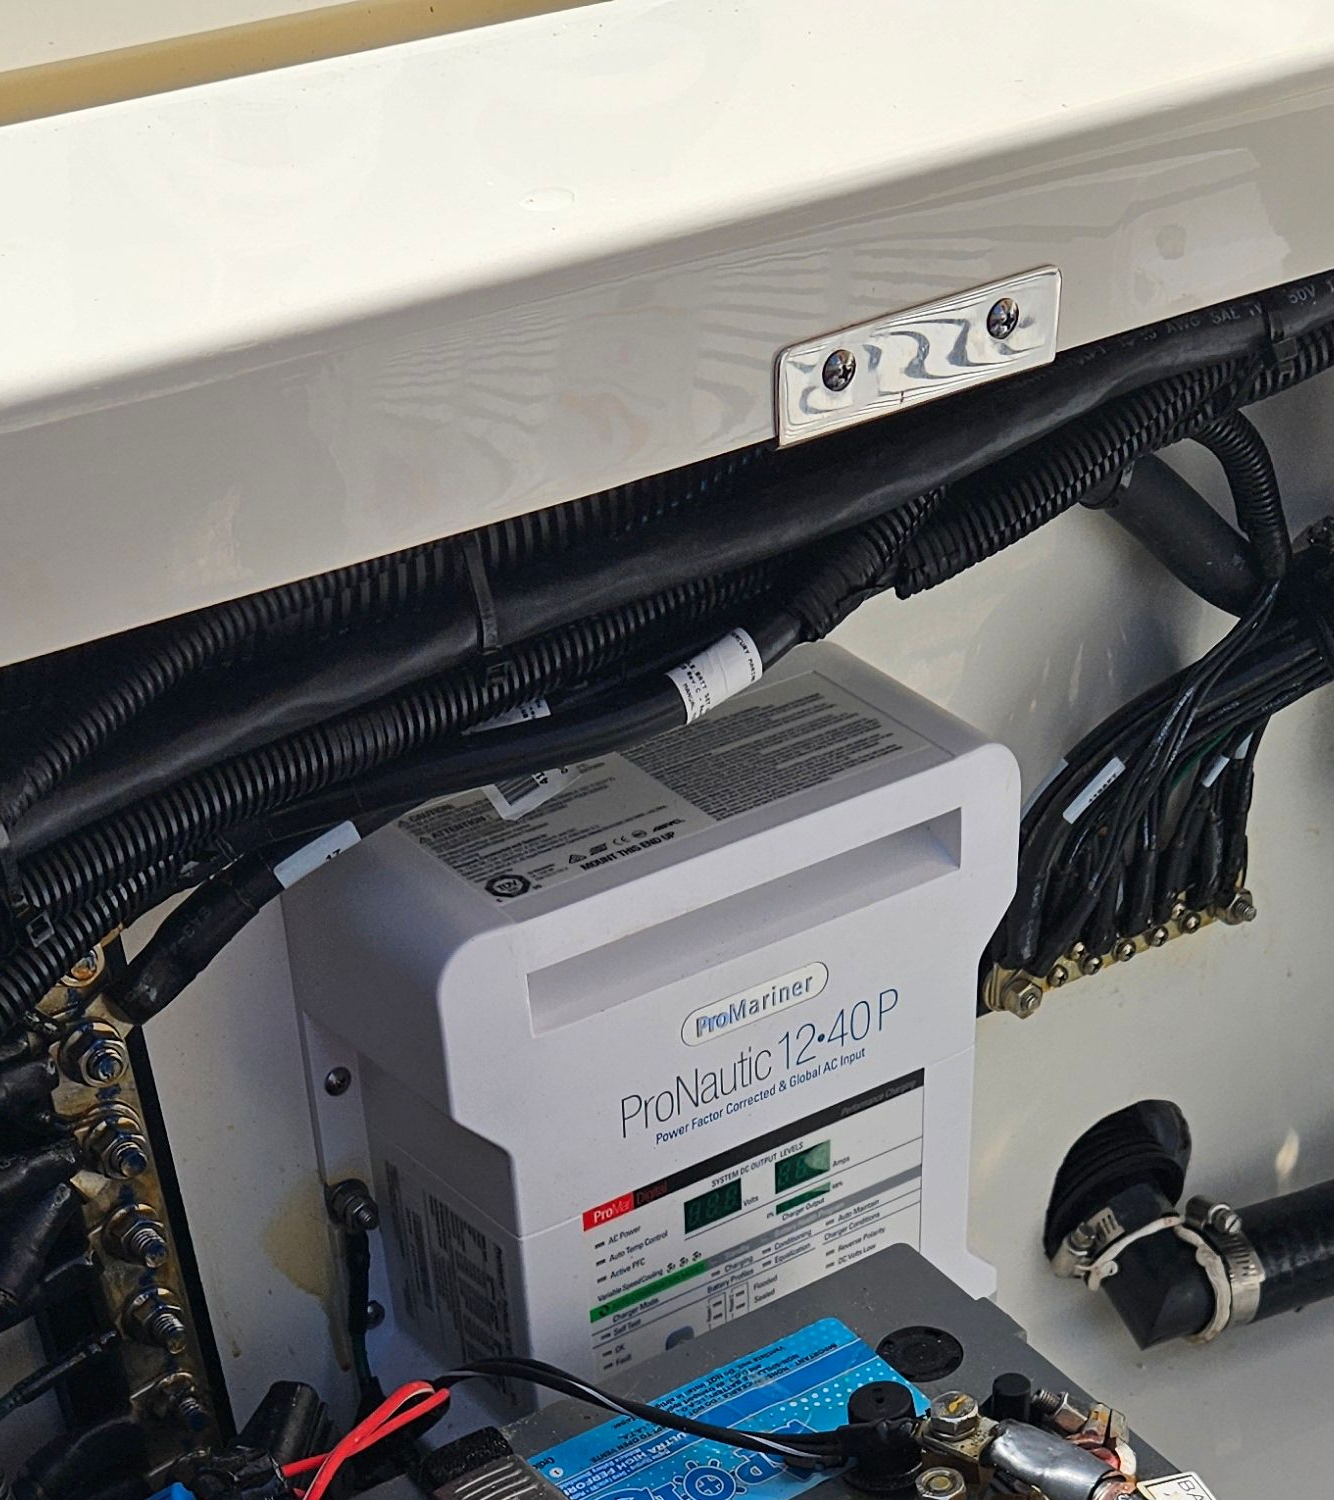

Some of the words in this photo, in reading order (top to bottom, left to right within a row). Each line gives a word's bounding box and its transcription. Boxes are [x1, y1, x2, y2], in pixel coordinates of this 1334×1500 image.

[695, 973, 814, 1038] ProMariner
[620, 1047, 773, 1139] ProNautic
[655, 1123, 689, 1145] Power
[691, 1107, 724, 1131] Factor
[726, 1084, 777, 1116] Corrected
[779, 1079, 787, 1091] &
[789, 1066, 821, 1089] Global
[823, 1057, 839, 1075] AC
[840, 1047, 866, 1070] Input
[711, 1168, 739, 1188] SYSTEM
[750, 1151, 779, 1172] OUTPUT
[779, 1141, 804, 1158] LEVELS
